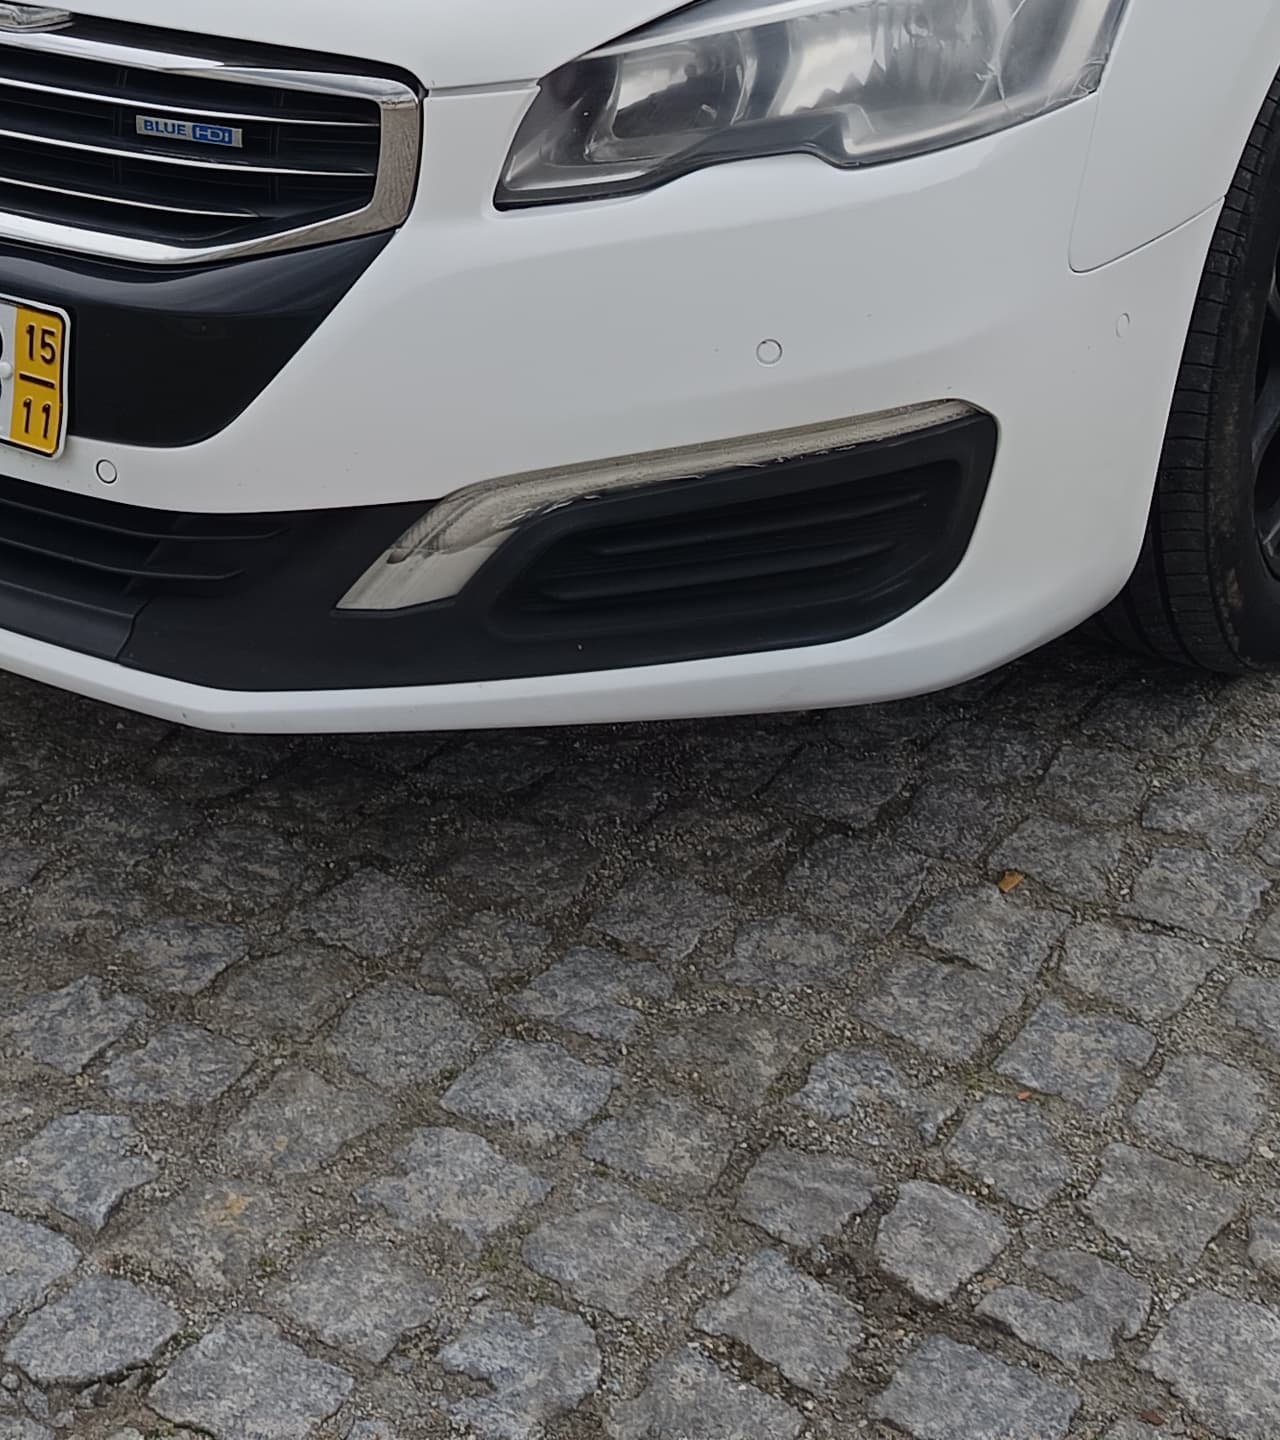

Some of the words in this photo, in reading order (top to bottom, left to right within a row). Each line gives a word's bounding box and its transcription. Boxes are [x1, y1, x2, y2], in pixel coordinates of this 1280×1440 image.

[143, 119, 187, 136] BLUE
[25, 323, 57, 366] 15
[22, 398, 53, 440] 11
